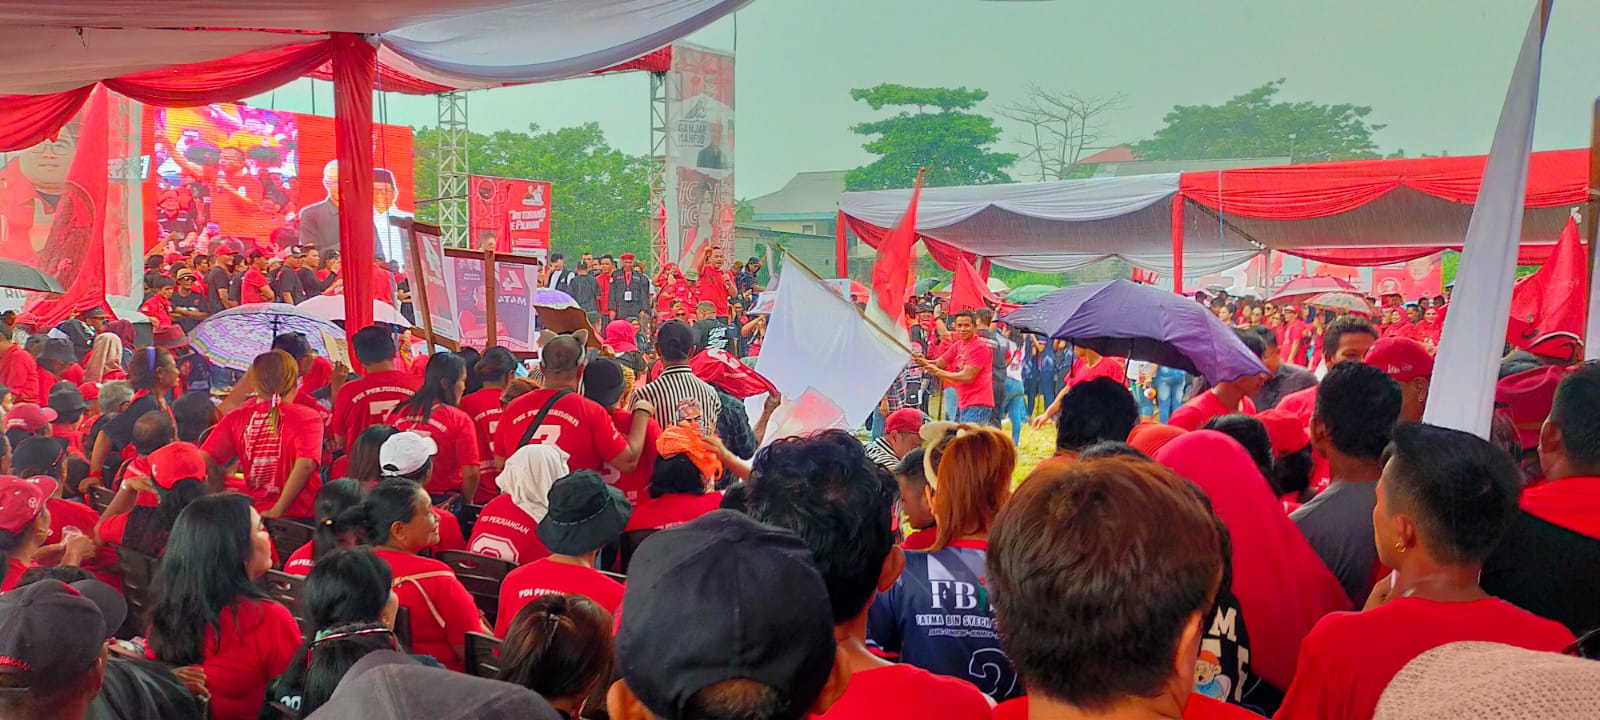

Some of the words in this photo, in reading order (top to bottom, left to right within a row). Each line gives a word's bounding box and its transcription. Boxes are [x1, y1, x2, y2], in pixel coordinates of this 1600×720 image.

[489, 515, 530, 535] PERJUANGAN
[518, 588, 533, 599] PDI
[945, 614, 961, 627] BIN
